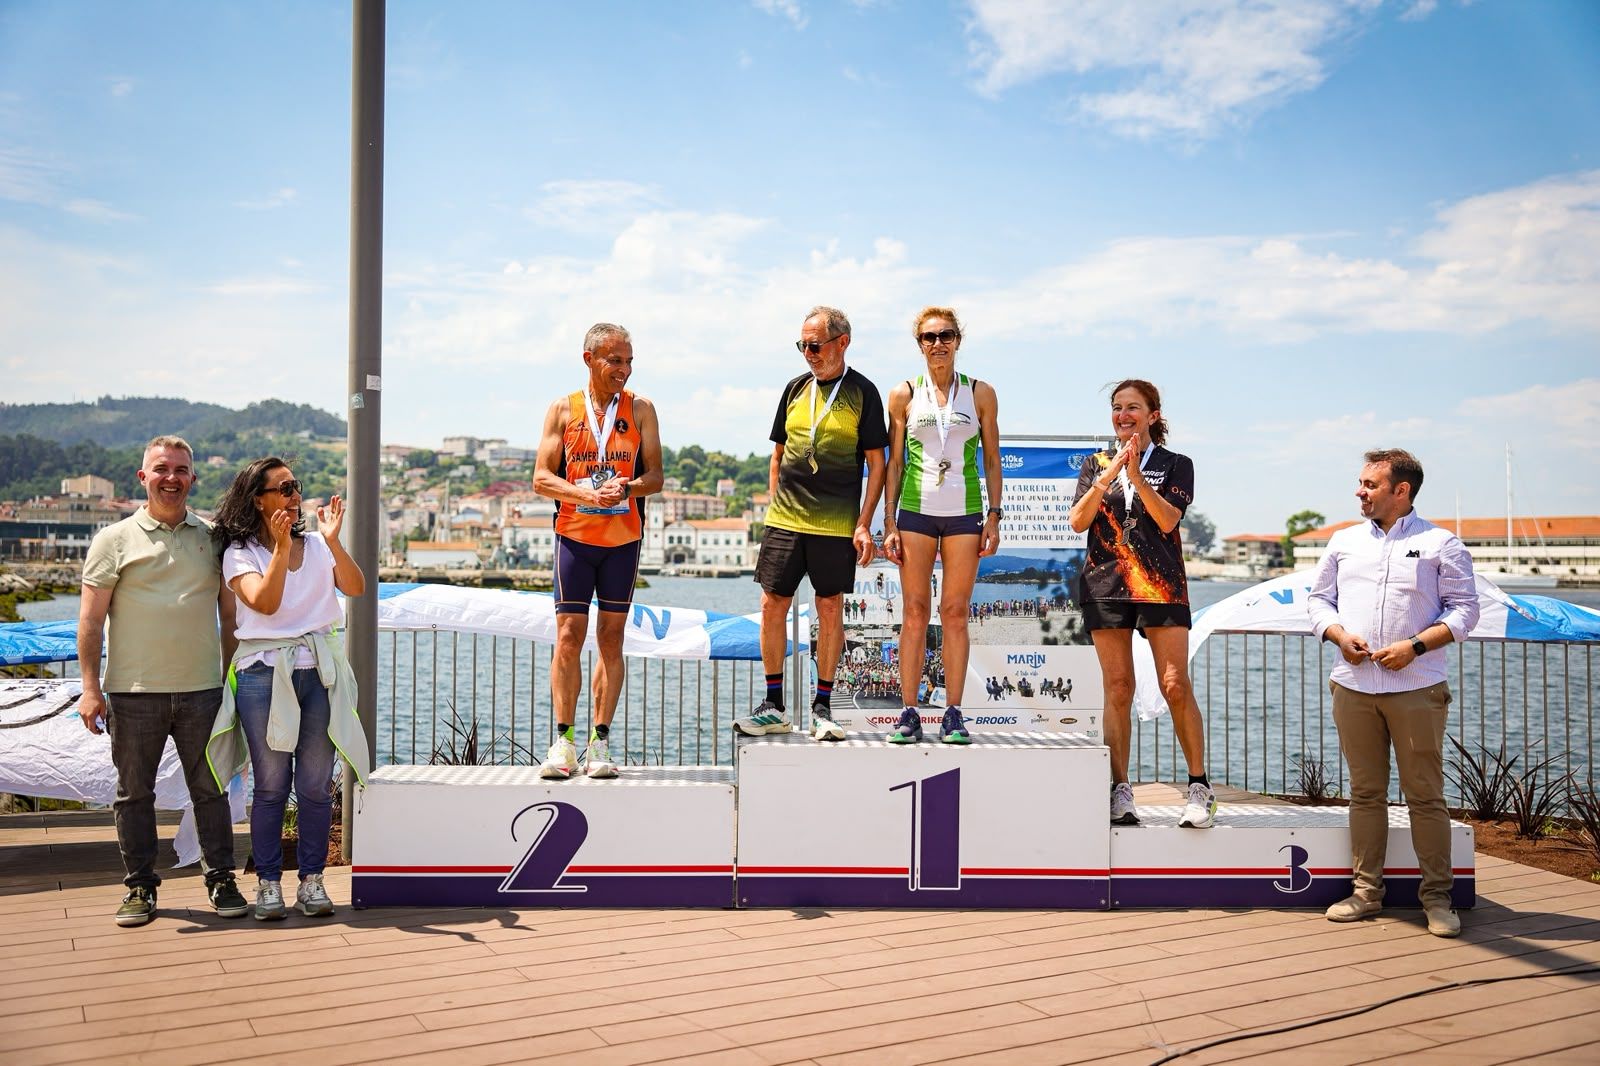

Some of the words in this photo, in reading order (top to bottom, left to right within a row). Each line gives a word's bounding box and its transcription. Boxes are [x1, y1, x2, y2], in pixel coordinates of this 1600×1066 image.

[871, 716, 944, 725] CROWRIKE
[975, 716, 1018, 725] BROOKS
[498, 801, 589, 893] 2
[889, 767, 961, 892] 1
[1273, 844, 1313, 894] 3
